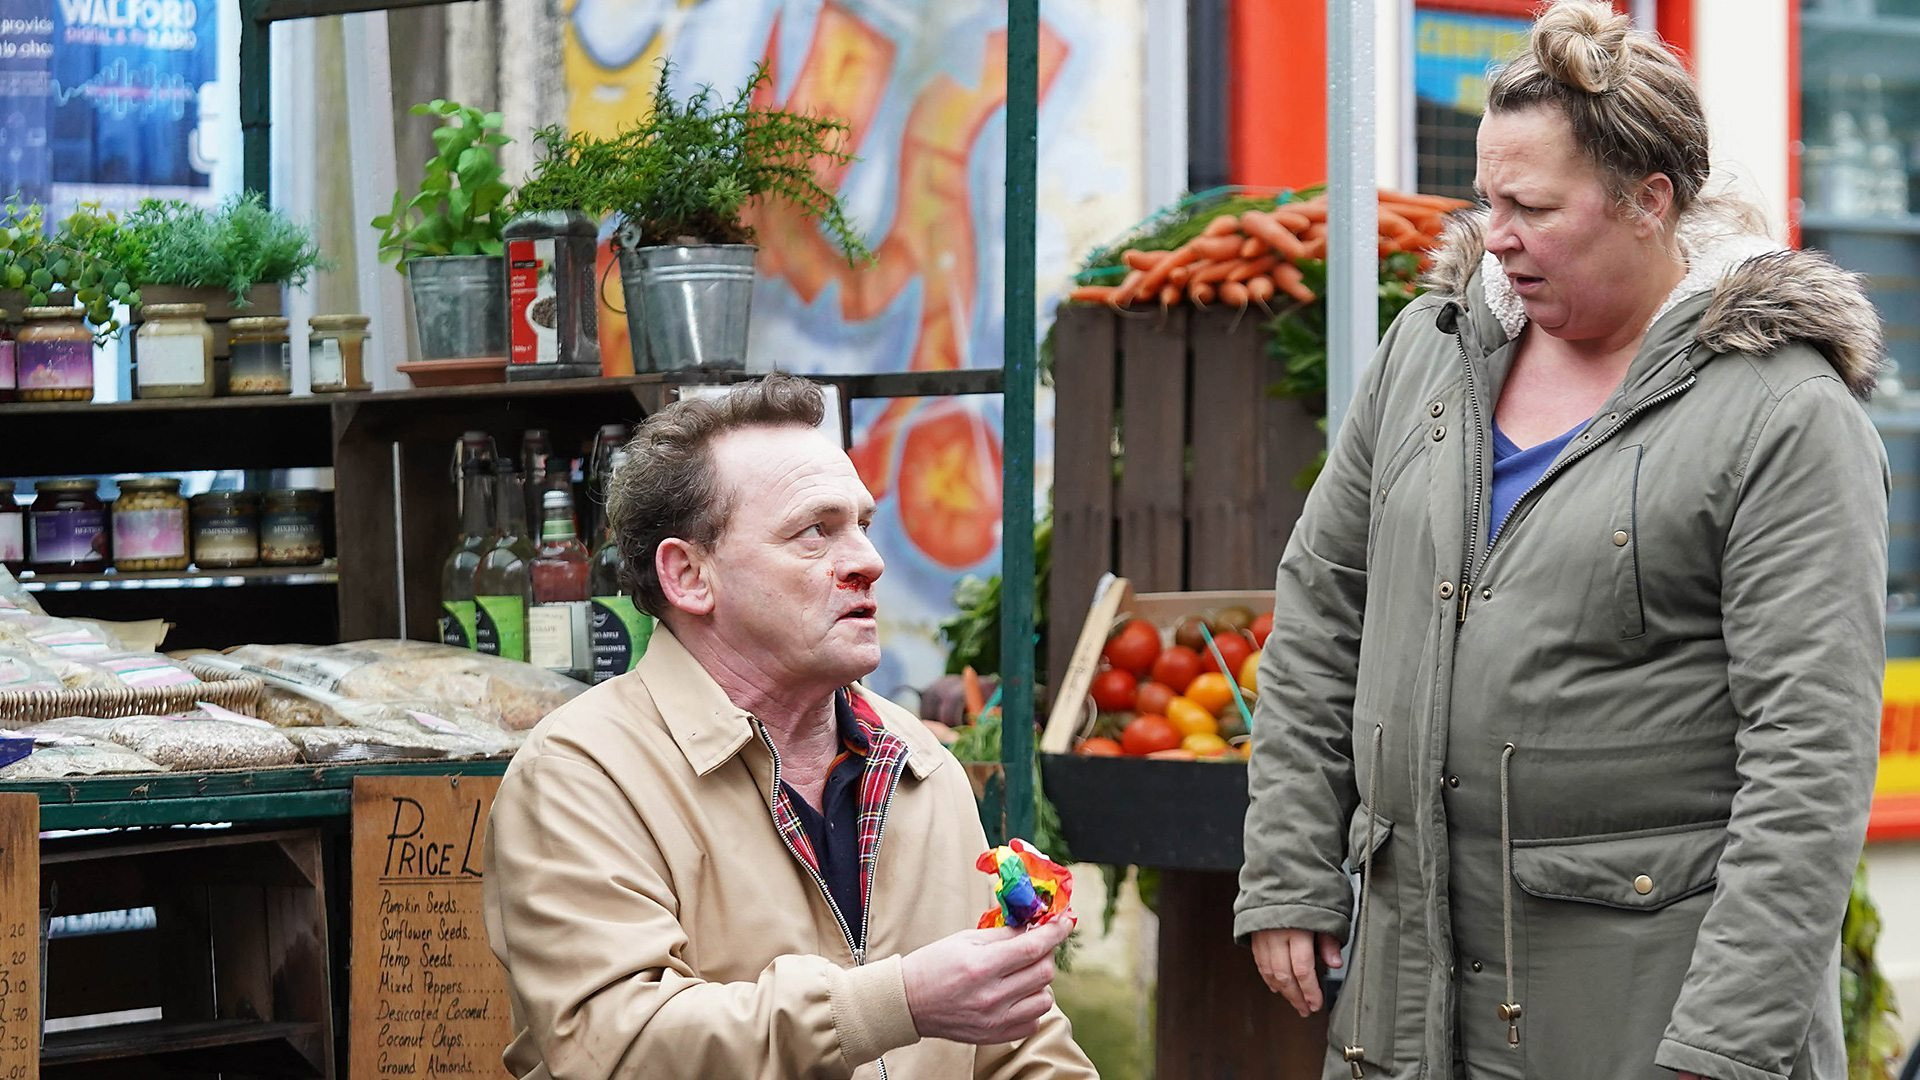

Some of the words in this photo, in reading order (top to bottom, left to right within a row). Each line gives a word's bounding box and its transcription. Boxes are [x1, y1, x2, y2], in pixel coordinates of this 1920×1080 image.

[61, 0, 198, 28] WALFORD
[461, 799, 483, 877] L
[378, 889, 421, 917] Pumpkin
[380, 917, 432, 950] Sunflower
[379, 944, 410, 976] Hemp
[378, 971, 414, 994] Mixed
[376, 999, 440, 1022] Desiccated
[378, 1023, 425, 1048] Coconut
[377, 1051, 416, 1074] Ground
